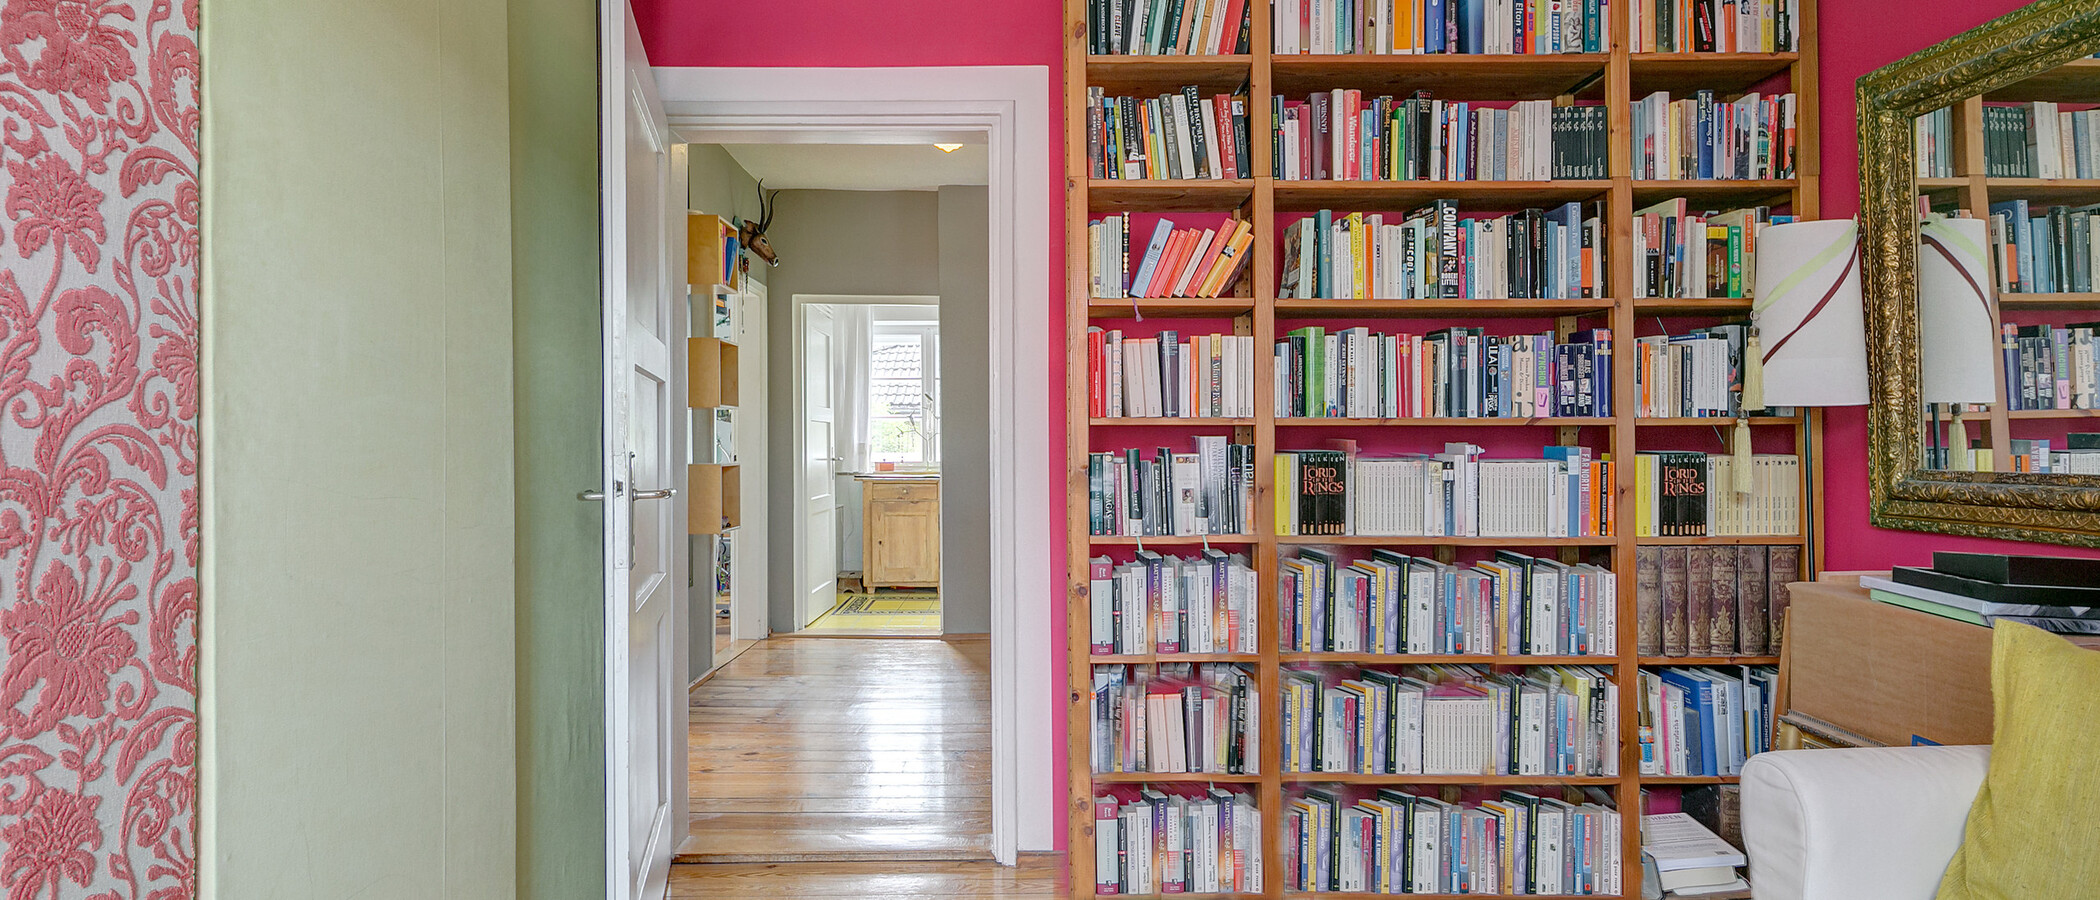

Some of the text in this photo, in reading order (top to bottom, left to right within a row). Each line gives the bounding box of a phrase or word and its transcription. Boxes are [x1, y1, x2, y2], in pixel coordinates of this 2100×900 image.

[1114, 14, 1122, 38] CLEAVE
[1515, 2, 1524, 26] Elton
[1552, 15, 1560, 44] RHAPSODY
[1320, 98, 1328, 133] HANNIBAL
[1383, 98, 1392, 128] Hemingway
[1348, 115, 1358, 163] Wanderer
[1442, 206, 1457, 256] COMPANY
[1406, 249, 1415, 272] COOL
[1488, 346, 1498, 364] LILA
[1212, 361, 1220, 385] Adam
[1538, 351, 1547, 386] PYNCHON
[1212, 392, 1220, 406] Eve
[1242, 463, 1254, 487] frau
[1303, 464, 1337, 481] LORD
[1580, 453, 1590, 492] FAR NORTH
[1664, 465, 1698, 482] LORD
[1302, 481, 1344, 496] RINGS
[1663, 482, 1705, 496] RINGS
